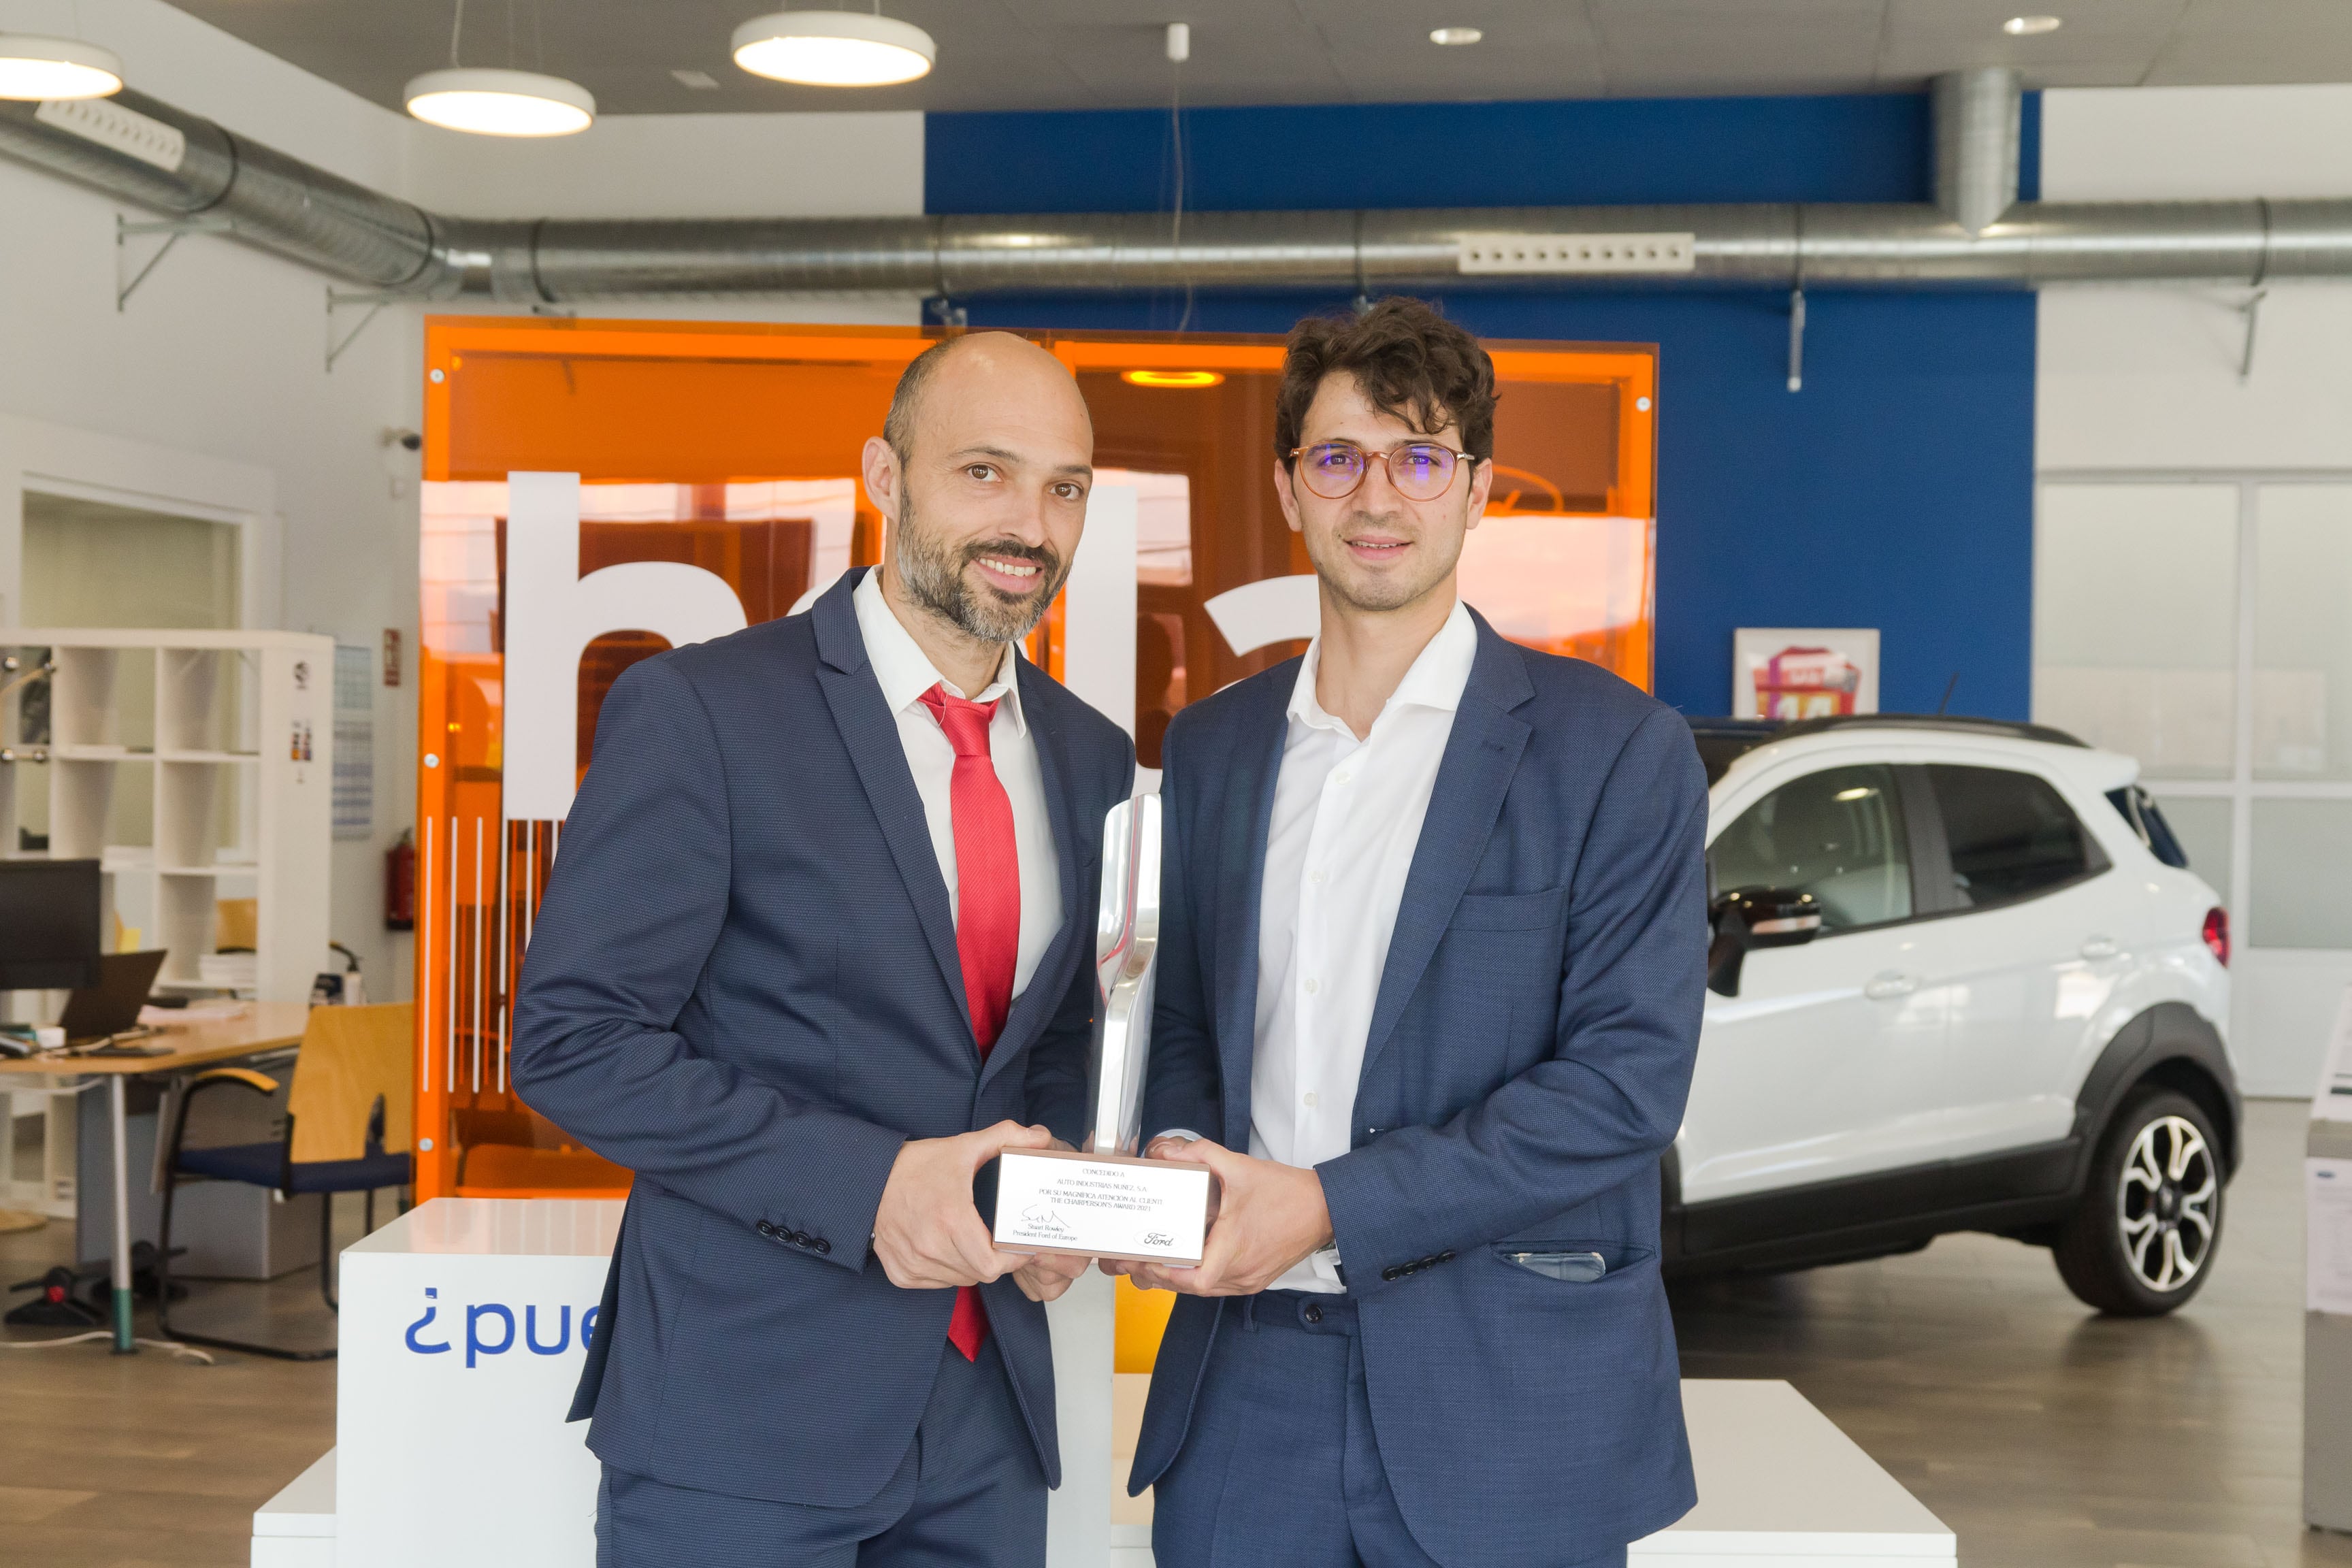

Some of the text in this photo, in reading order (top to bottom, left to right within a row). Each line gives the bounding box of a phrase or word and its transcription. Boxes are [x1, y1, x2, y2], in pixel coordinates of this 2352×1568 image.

[1082, 1168, 1119, 1177] CONCEDIDO
[1076, 1179, 1112, 1189] INDUSTRIAS
[1045, 1224, 1064, 1232] Rowley
[1013, 1229, 1036, 1237] President
[1144, 1232, 1174, 1246] Ford
